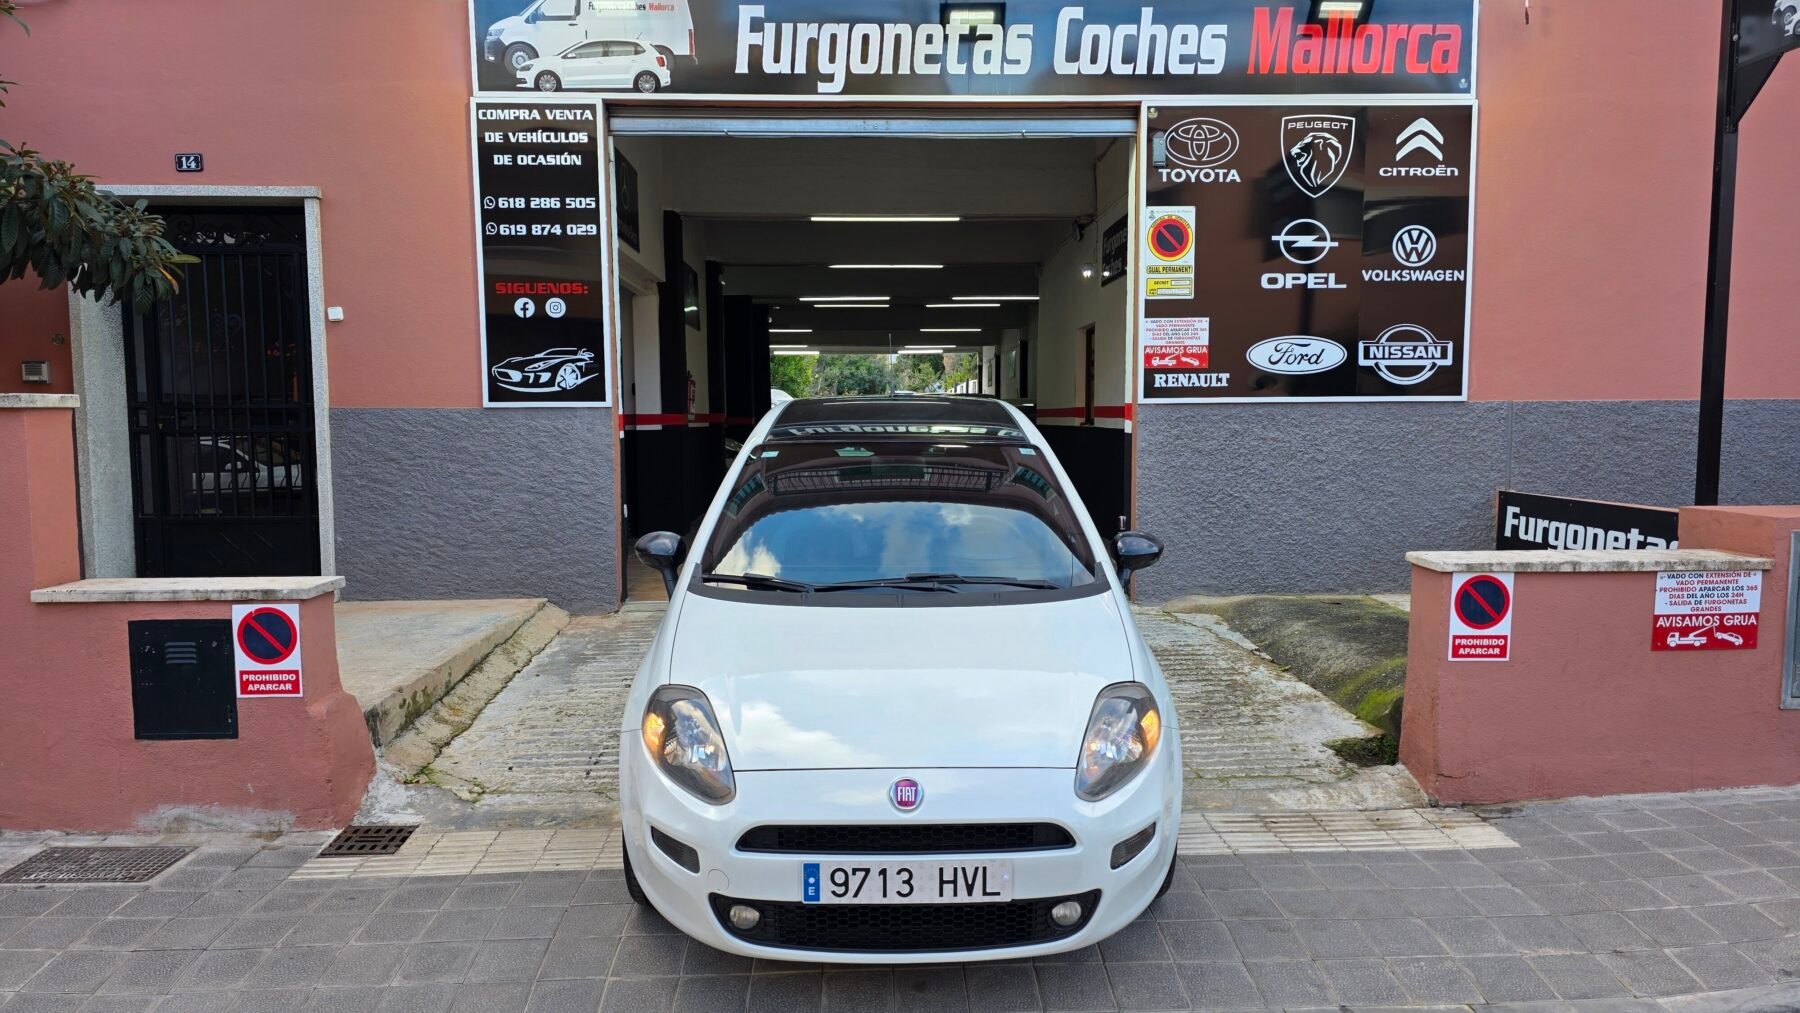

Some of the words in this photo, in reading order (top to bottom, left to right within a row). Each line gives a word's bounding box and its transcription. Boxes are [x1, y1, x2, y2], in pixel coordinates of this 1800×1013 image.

[735, 4, 1033, 93] Furgonetas
[1054, 6, 1228, 75] Coches
[1247, 6, 1462, 75] Mallorca
[478, 109, 541, 120] COMPRA
[545, 109, 593, 120] VENTA
[1287, 121, 1349, 130] PEUGEOT
[484, 132, 503, 142] DE
[508, 130, 589, 143] VEHÍCULOS
[181, 156, 197, 169] 14
[493, 154, 512, 165] DE
[517, 152, 582, 165] OCASIÓN
[1158, 169, 1241, 183] TOYOTA
[498, 198, 525, 208] 618
[530, 198, 560, 208] 286
[565, 198, 596, 208] 505
[499, 224, 526, 235] 619
[531, 224, 562, 235] 874
[566, 224, 597, 235] 029
[1260, 272, 1347, 289] OPEL
[1361, 269, 1465, 282] VOLKSWAGEN
[495, 282, 589, 294] SIGUENOS:
[1145, 346, 1185, 354] AVISAMOS
[1186, 346, 1208, 354] GRUA
[1268, 341, 1325, 366] Ford
[1369, 346, 1441, 359] NISSAN
[1153, 373, 1230, 388] RENAULT
[1504, 505, 1679, 550] Furgoneta
[1699, 591, 1715, 599] AÑO
[1656, 615, 1720, 627] AVISAMOS
[1723, 614, 1757, 625] GRUA
[1455, 638, 1505, 646] PROHIBIDO
[1458, 647, 1500, 655] APARCAR
[242, 673, 296, 681] PROHIBIDO
[247, 683, 292, 691] APARCAR
[897, 786, 917, 802] FIAT
[830, 867, 914, 898] 9713
[939, 866, 1001, 897] HVL
[808, 886, 815, 896] E
